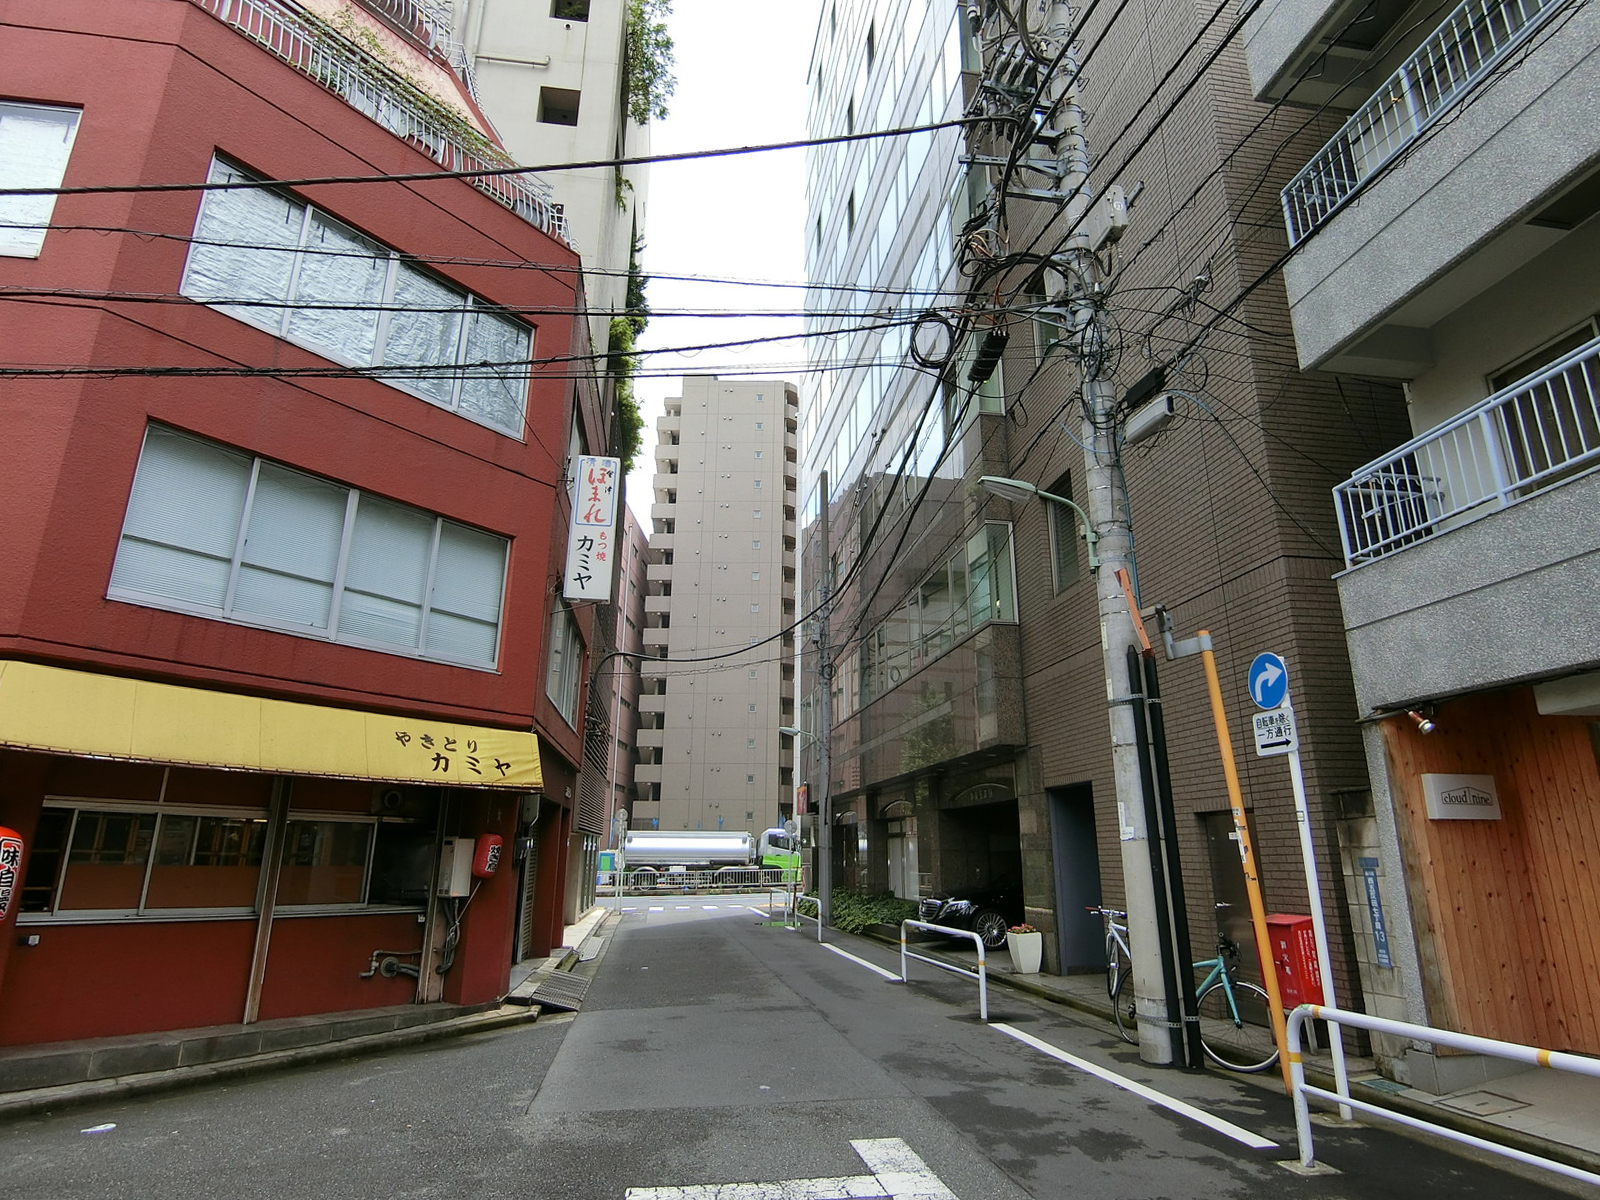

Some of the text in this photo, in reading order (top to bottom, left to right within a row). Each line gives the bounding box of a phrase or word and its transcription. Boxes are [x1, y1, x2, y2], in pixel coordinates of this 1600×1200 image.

[584, 468, 608, 523] ほまれ
[596, 531, 607, 562] もつ焼
[573, 535, 595, 590] カミヤ
[1256, 713, 1290, 729] 自転車を除く
[1257, 725, 1292, 740] 一方通行
[395, 731, 478, 754] やきとり
[431, 752, 511, 776] カミヤ
[1443, 790, 1490, 805] cloud nine
[1374, 931, 1386, 942] 13
